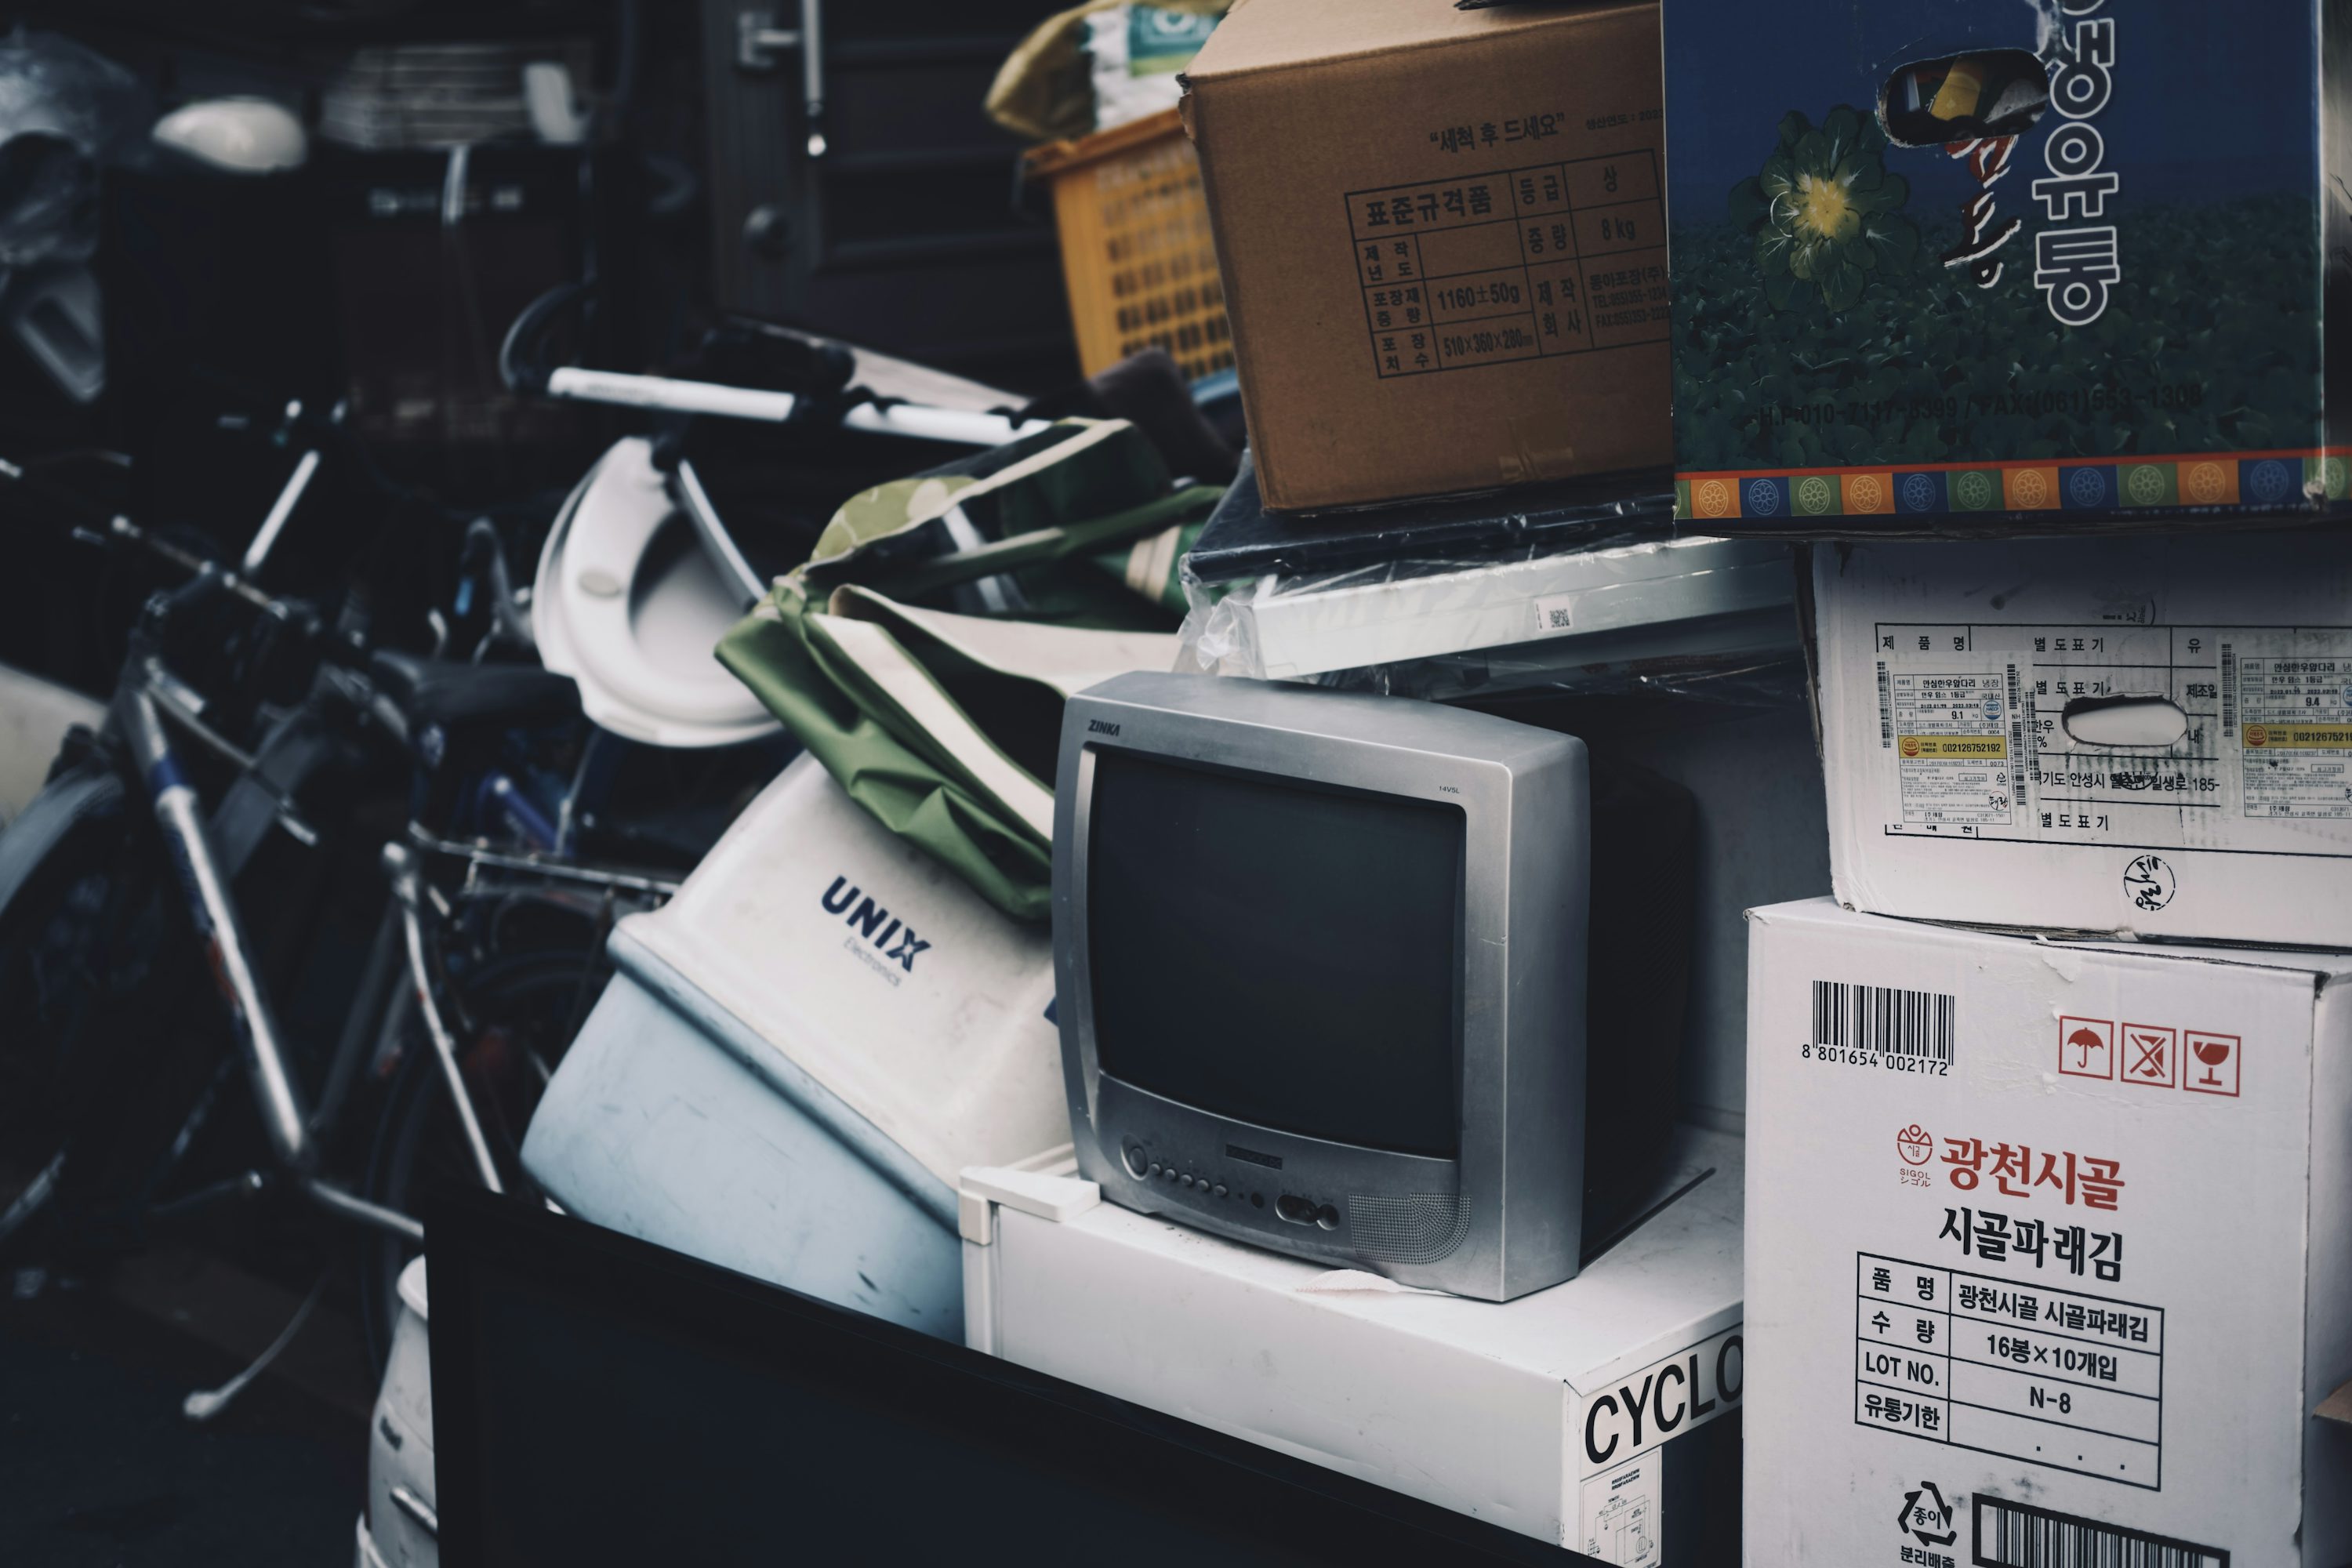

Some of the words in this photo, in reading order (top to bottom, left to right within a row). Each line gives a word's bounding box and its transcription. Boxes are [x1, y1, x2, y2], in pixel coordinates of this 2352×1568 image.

[1480, 123, 1499, 147] 후
[1602, 165, 1618, 194] 상
[1367, 185, 1492, 227] 표준규격품
[1951, 710, 1963, 720] 9.1
[2306, 696, 2320, 706] 9.4
[1087, 719, 1120, 737] ZINKA
[1942, 742, 2001, 753] 002126752192
[2071, 771, 2104, 789] 안성시
[822, 875, 931, 973] UNIX
[1818, 1046, 1878, 1068] 801654
[1886, 1054, 1948, 1076] 002172
[1900, 1168, 1931, 1180] SIGOL
[1900, 1176, 1931, 1187] シゴル
[1940, 1138, 2125, 1211] 광천시골
[1939, 1207, 2122, 1283] 시골파래김
[1958, 1283, 2039, 1322] 광천시골
[2045, 1301, 2148, 1343] 시골파래김
[1866, 1352, 1901, 1377] LOT
[1907, 1360, 1940, 1386] NO.
[1987, 1334, 2118, 1382] 16봉×10개입
[1864, 1393, 1940, 1431] 유통기한
[2029, 1385, 2071, 1414] N-8
[1913, 1506, 1940, 1530] 종이
